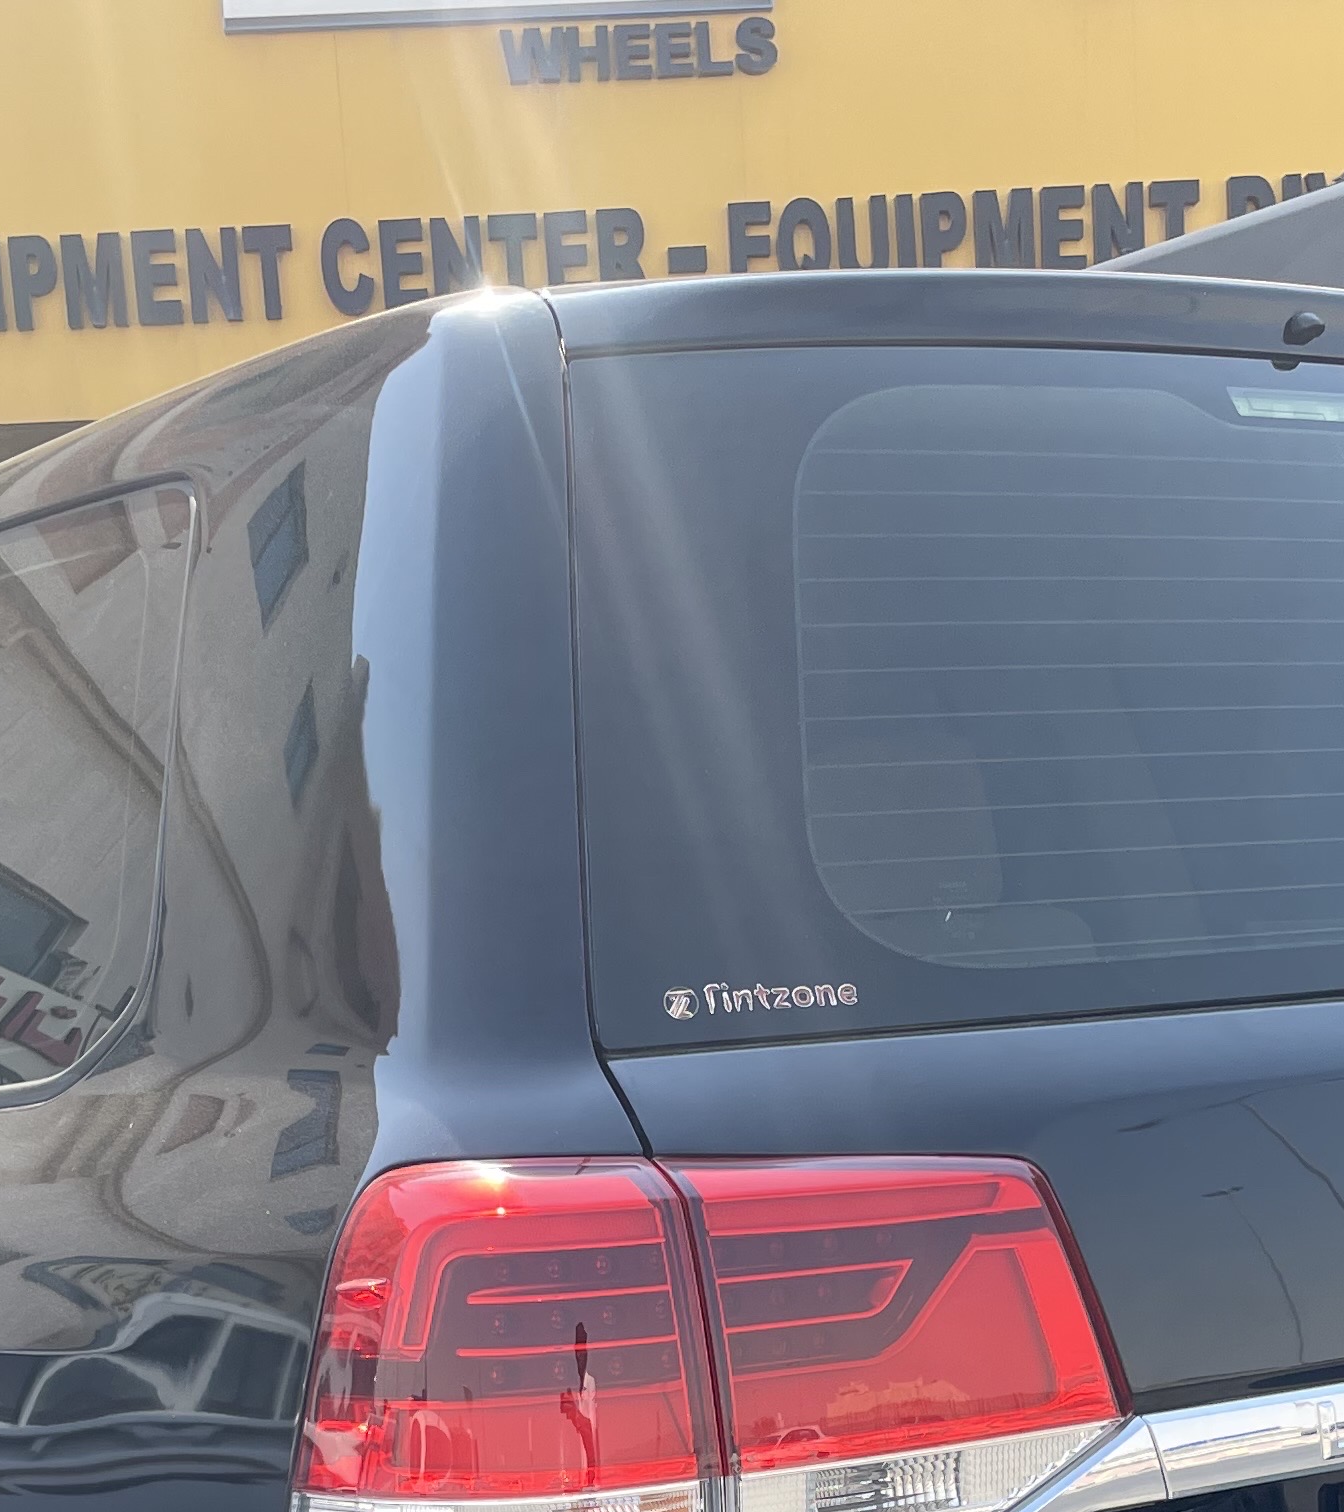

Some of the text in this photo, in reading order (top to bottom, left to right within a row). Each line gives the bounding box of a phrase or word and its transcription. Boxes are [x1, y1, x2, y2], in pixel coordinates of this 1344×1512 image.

[500, 17, 779, 86] WHEELS
[321, 207, 646, 317] CENTER
[727, 178, 1201, 274] EQUIPMENT
[702, 982, 859, 1015] Tintzone
